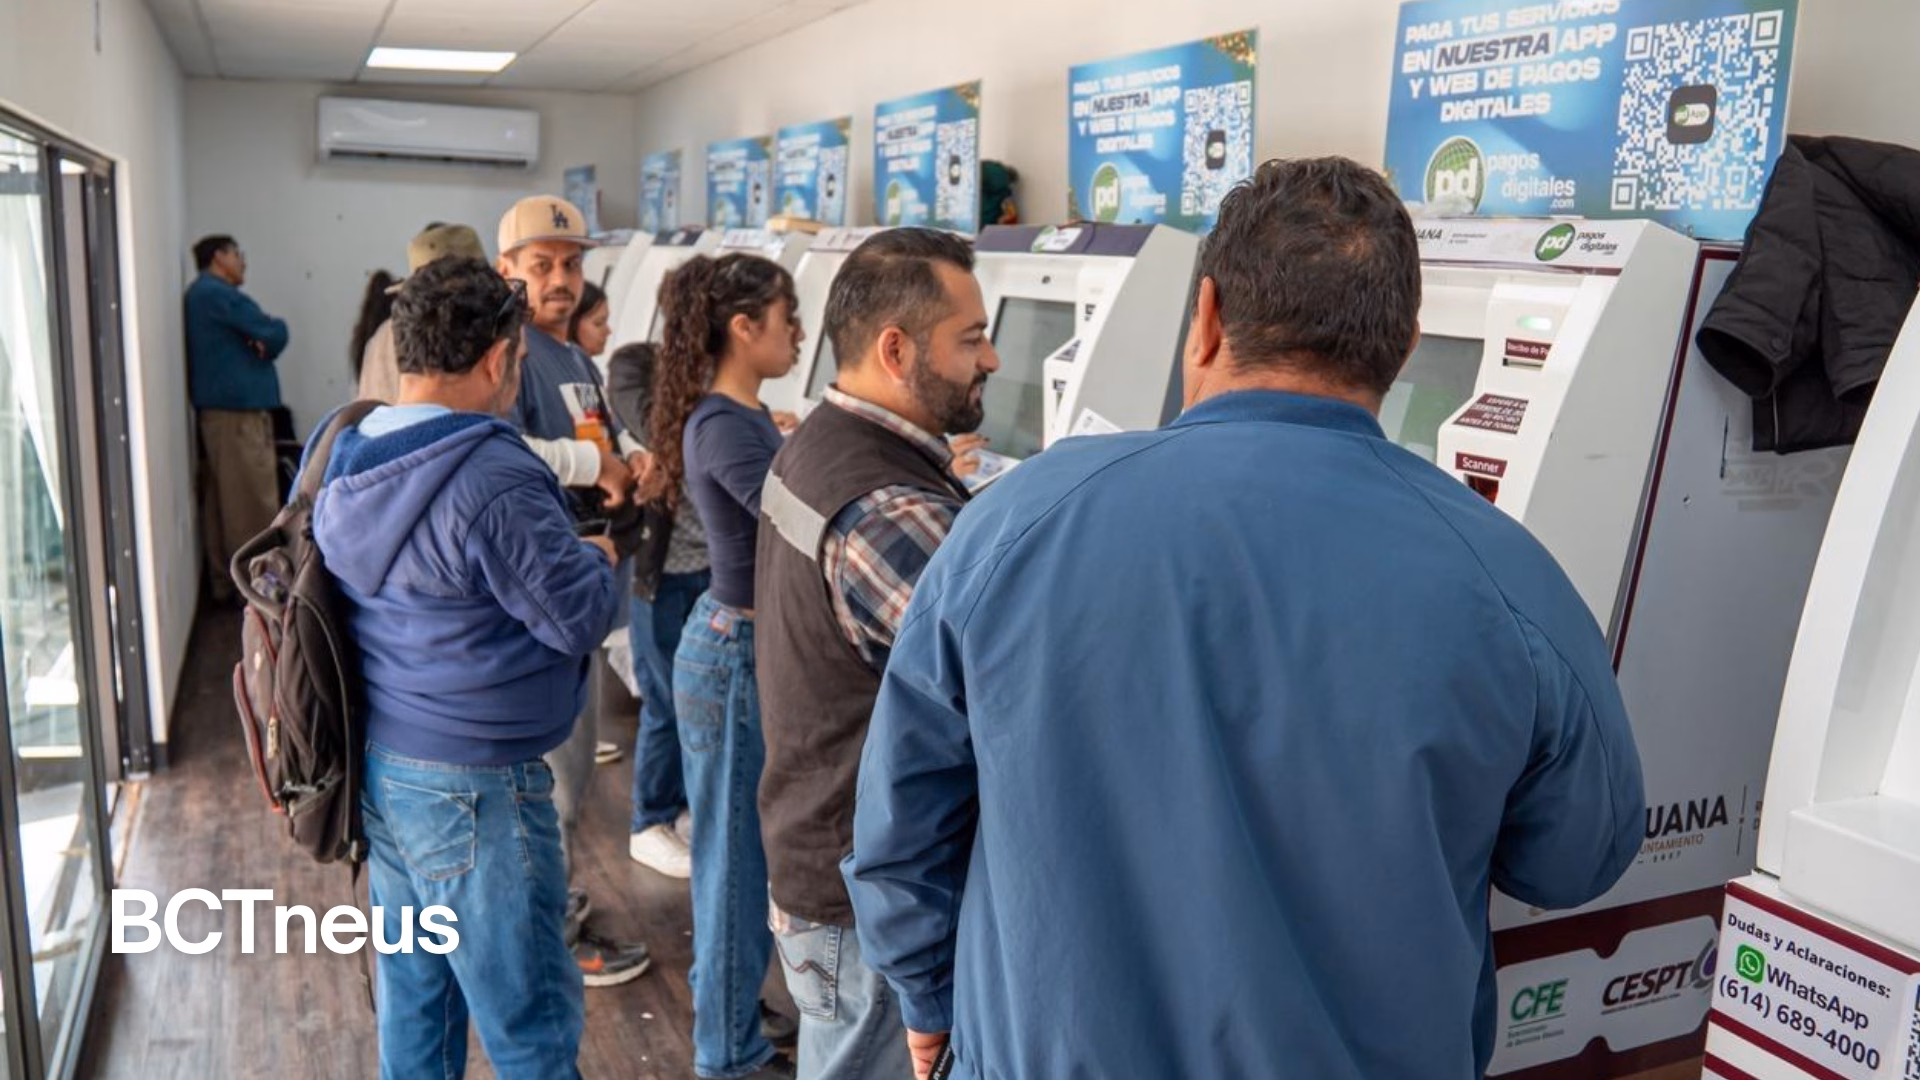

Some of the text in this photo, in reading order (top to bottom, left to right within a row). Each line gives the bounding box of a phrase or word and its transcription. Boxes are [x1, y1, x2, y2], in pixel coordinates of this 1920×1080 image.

[1405, 0, 1620, 44] PAGA TUS SERVICIOS
[1402, 23, 1617, 73] EN NUESTRA APP
[1409, 57, 1601, 98] Y WEB DE PAGOS
[1093, 91, 1150, 113] NUESTRA
[1440, 93, 1551, 122] DIGITALES
[1435, 158, 1478, 201] pd
[1487, 153, 1540, 171] pagos
[1501, 176, 1576, 202] digitales
[1539, 231, 1572, 254] pd
[1462, 457, 1499, 473] Scanner
[1728, 913, 1891, 999] Dudas y Aclaraciones:
[1511, 978, 1569, 1021] CFE
[1602, 960, 1694, 1006] CESPT
[1767, 964, 1869, 1030] WhatsApp
[1719, 975, 1770, 1019] (614)
[1777, 1005, 1880, 1070] 689-4000
